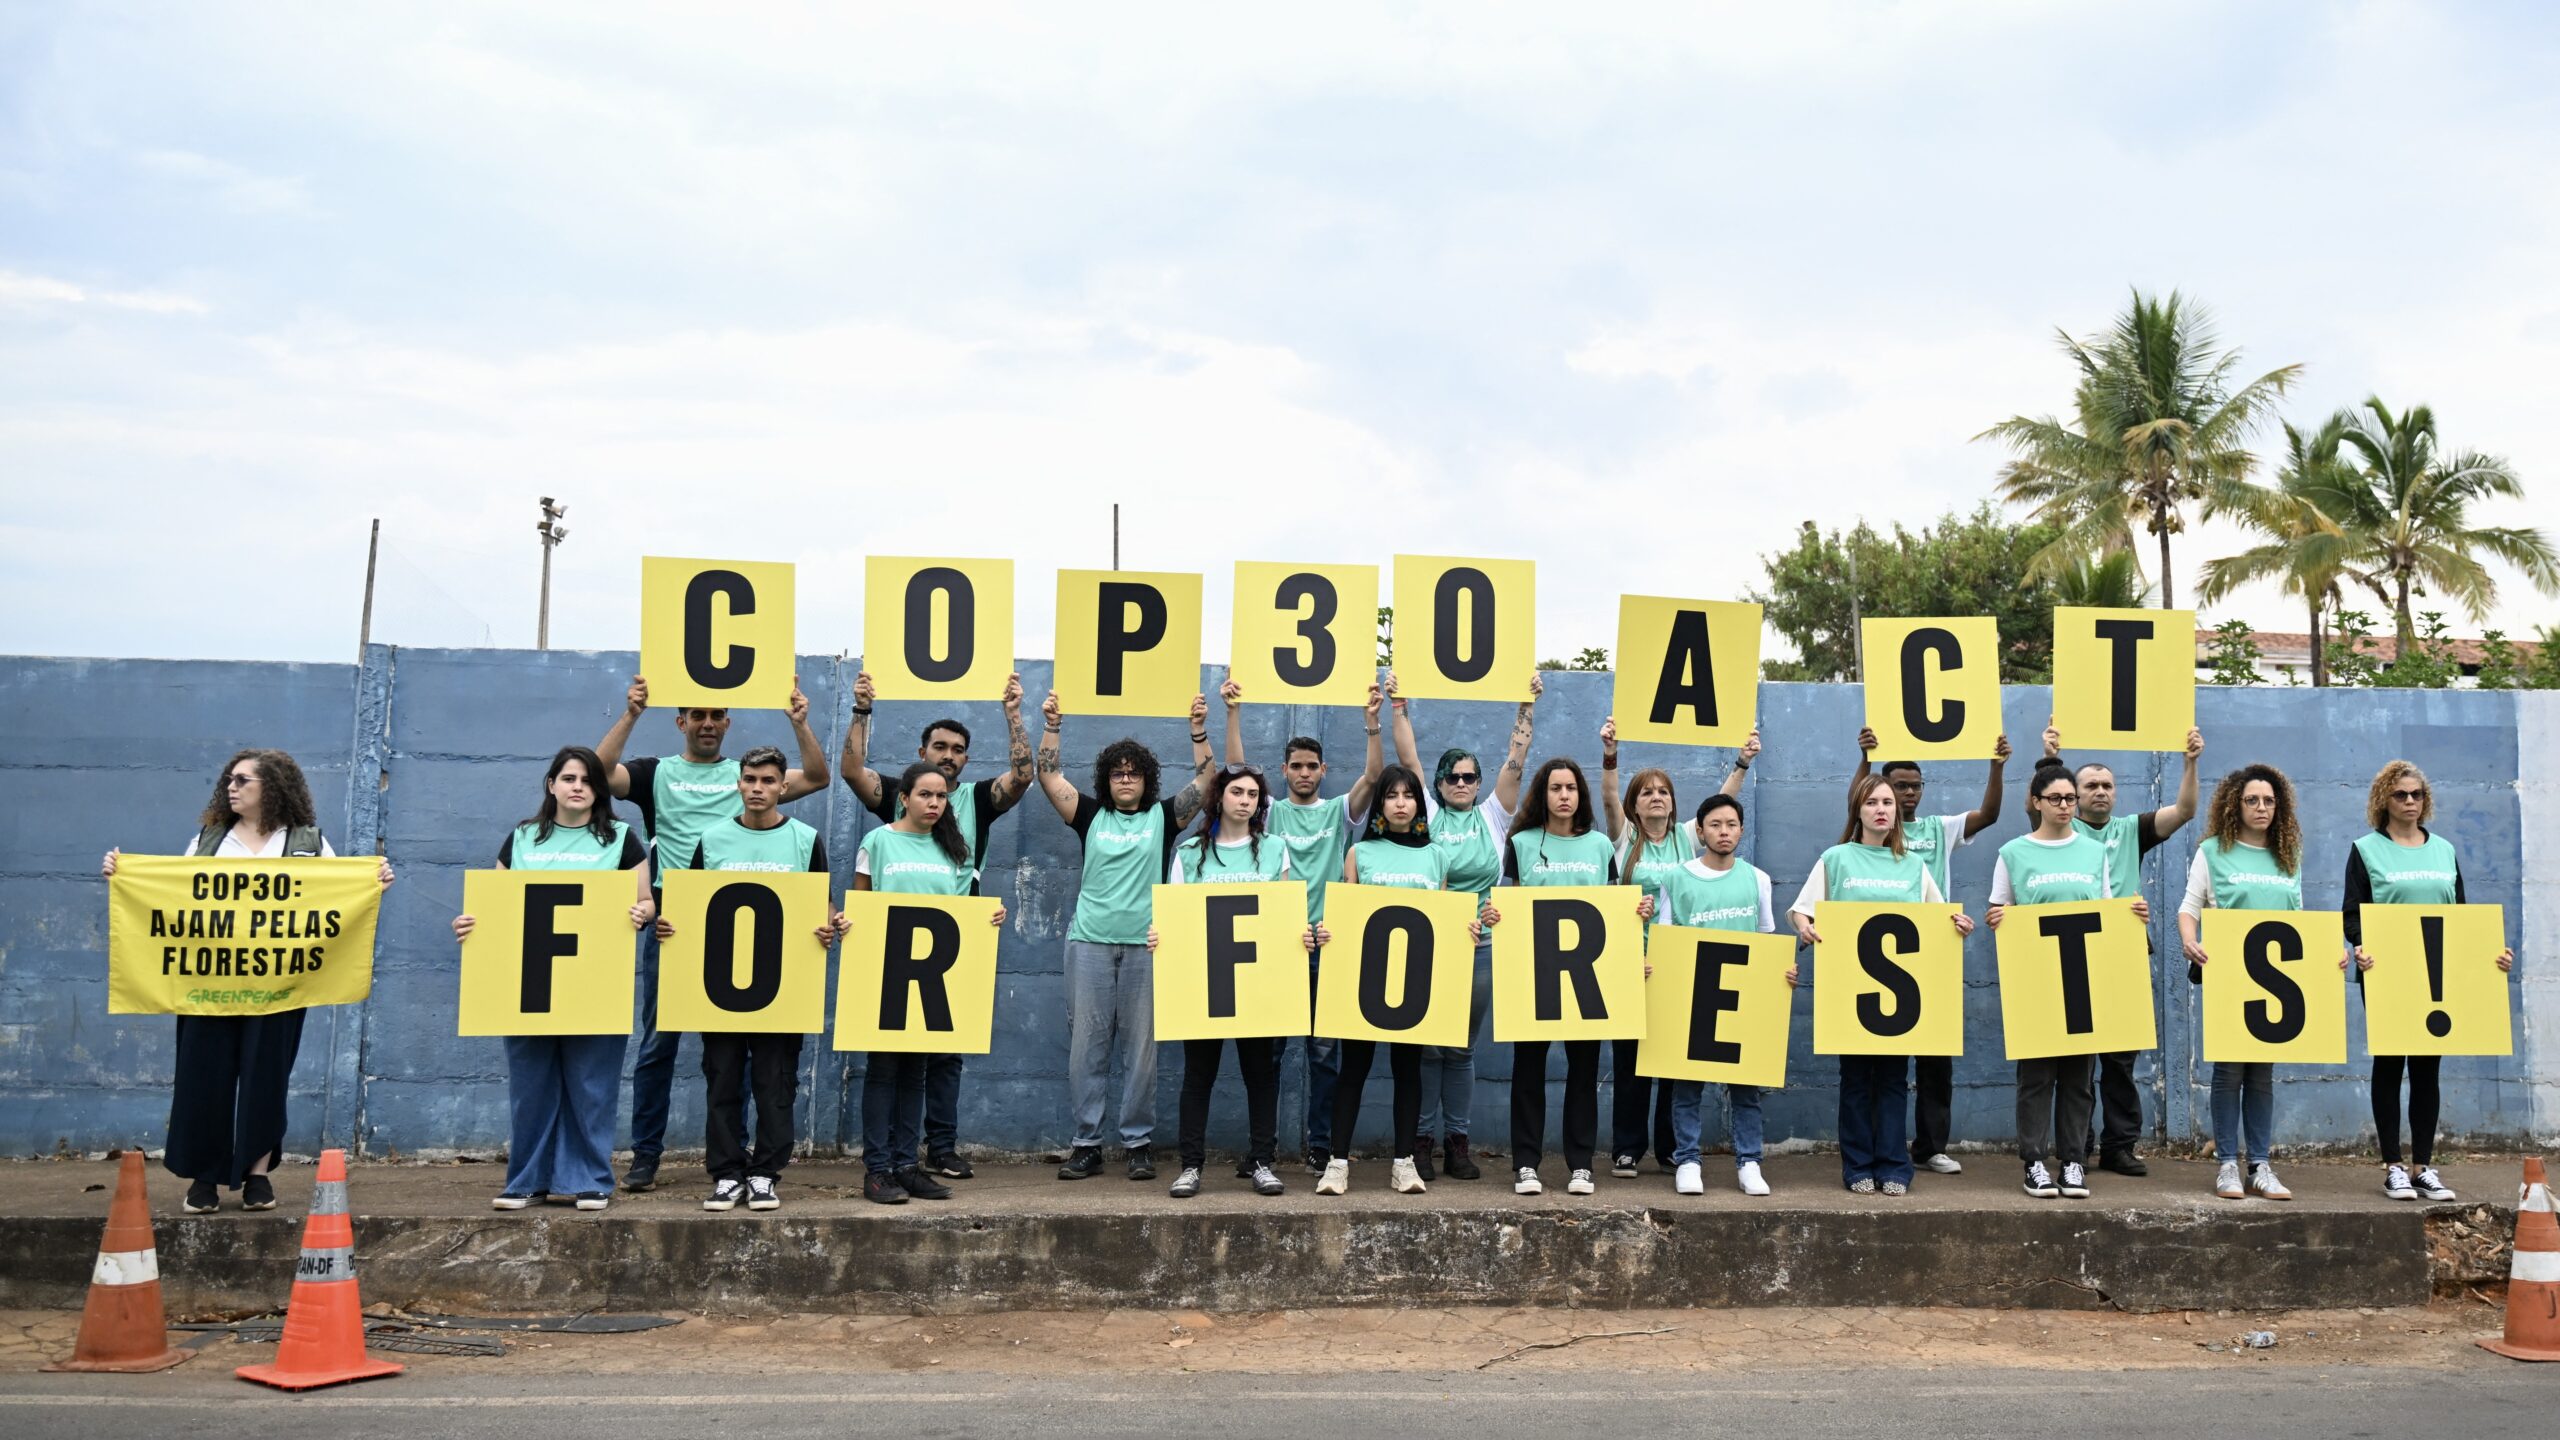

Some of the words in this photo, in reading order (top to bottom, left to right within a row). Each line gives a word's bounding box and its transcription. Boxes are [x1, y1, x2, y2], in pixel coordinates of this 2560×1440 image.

[192, 873, 303, 901] COP30:
[150, 909, 236, 938] AJAM
[249, 909, 342, 938] PELAS
[1689, 905, 1755, 926] GREENPEACE
[162, 946, 325, 977] FLORESTAS
[187, 987, 297, 1005] GREENPEACE
